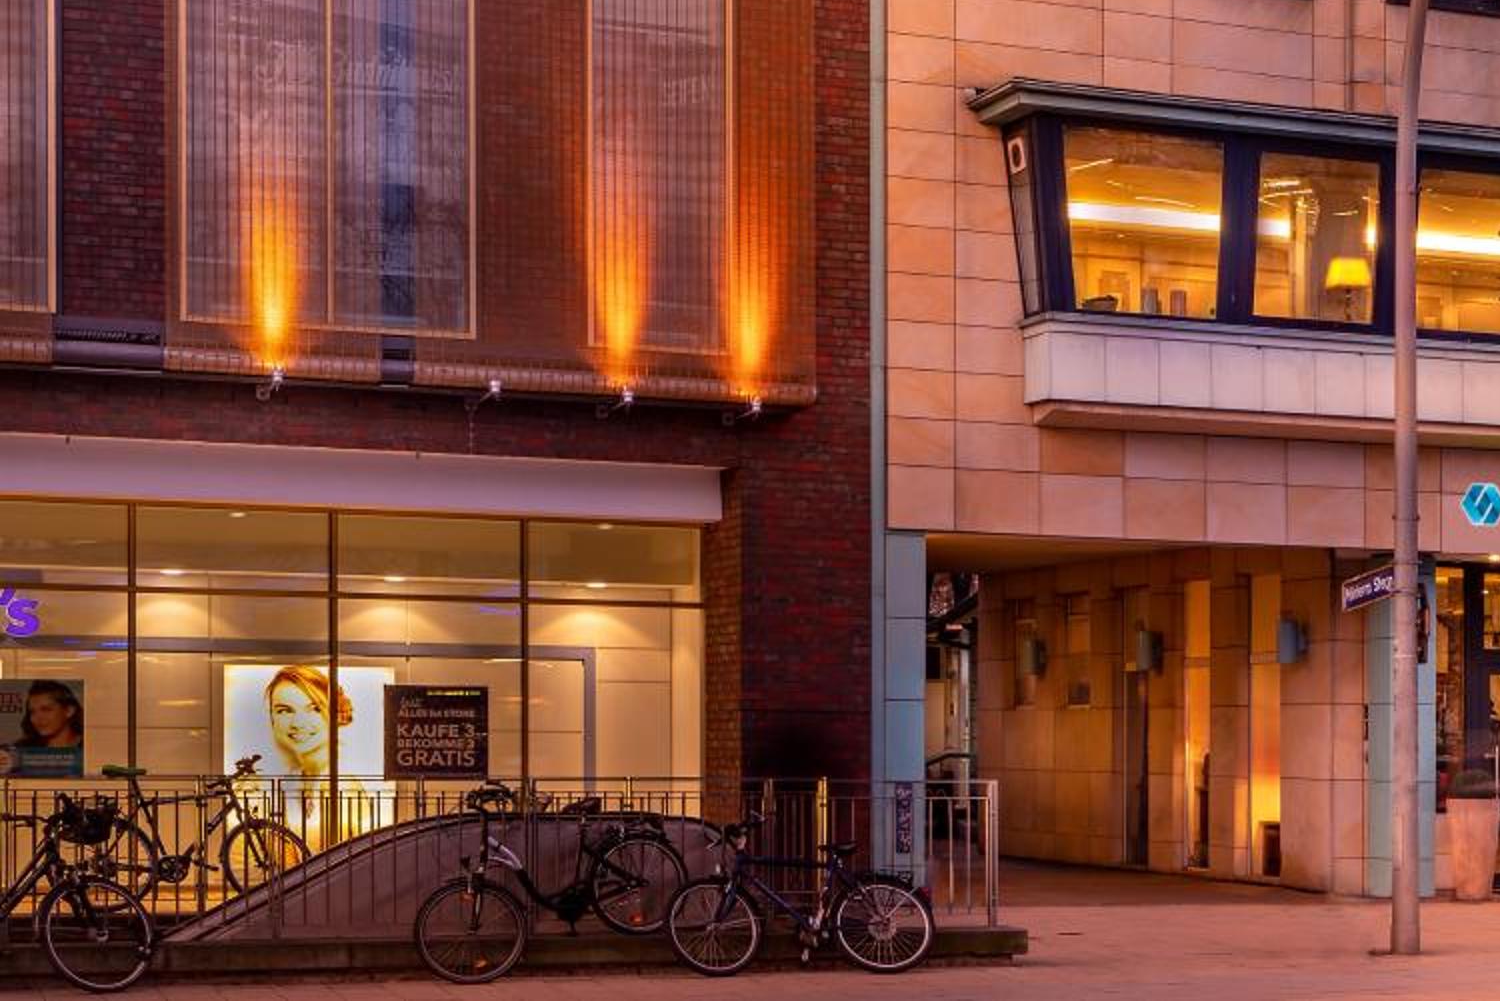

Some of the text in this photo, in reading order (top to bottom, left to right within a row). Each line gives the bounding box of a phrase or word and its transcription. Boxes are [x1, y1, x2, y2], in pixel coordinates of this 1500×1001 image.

[397, 723, 476, 738] KAUFE 3
[397, 749, 476, 767] GRATIS
